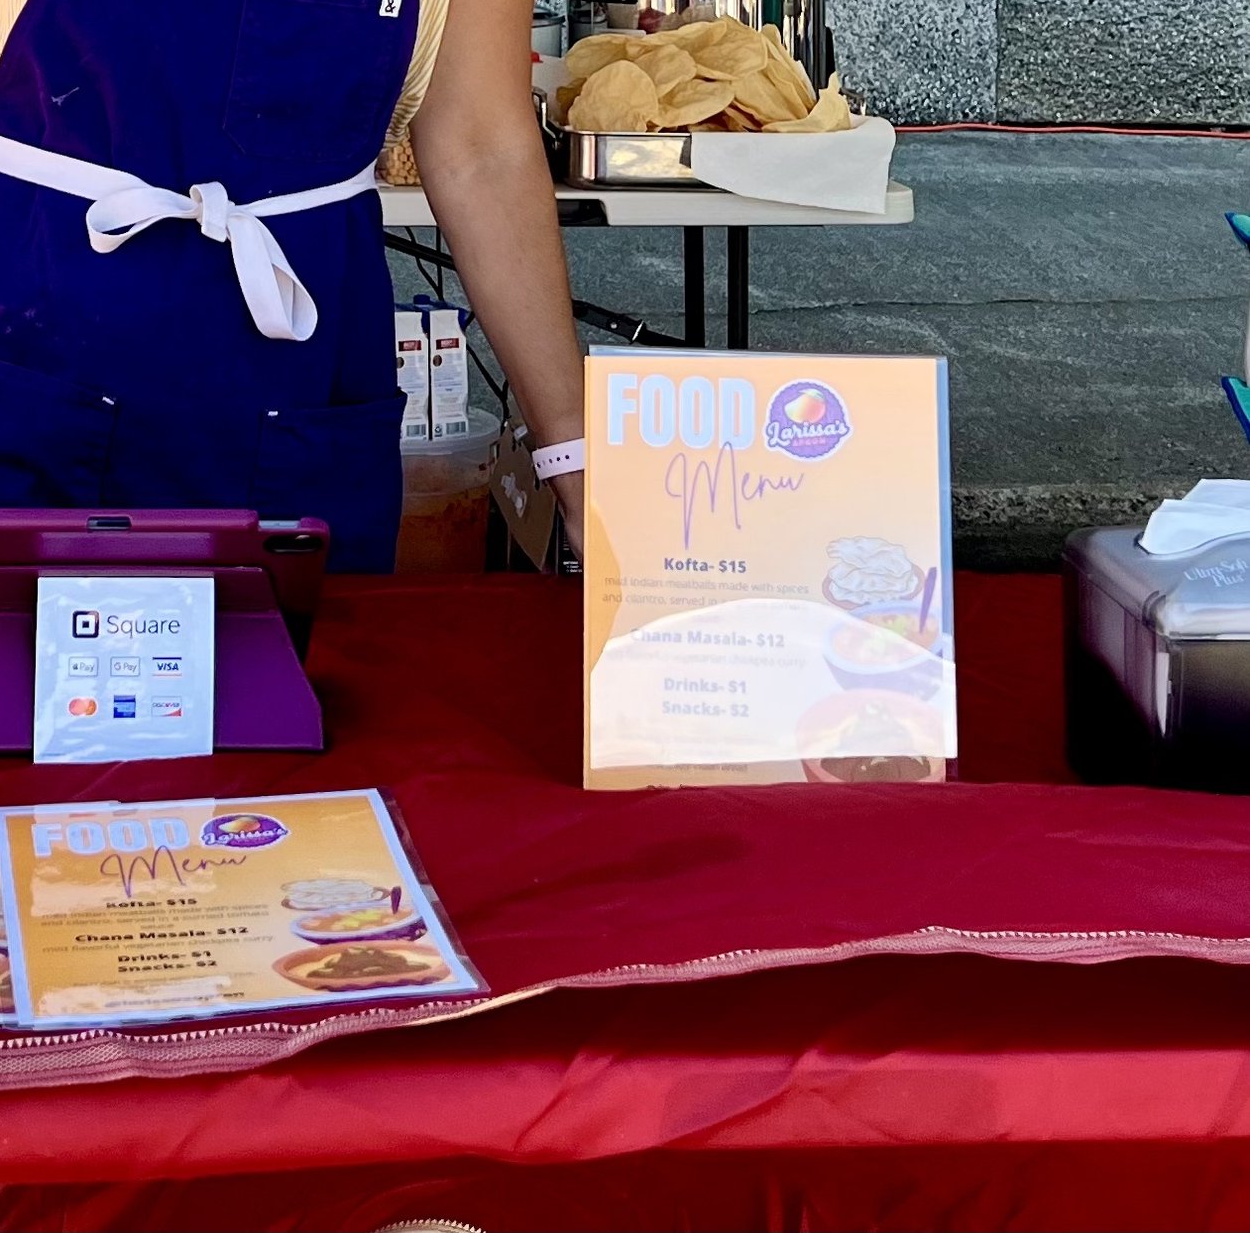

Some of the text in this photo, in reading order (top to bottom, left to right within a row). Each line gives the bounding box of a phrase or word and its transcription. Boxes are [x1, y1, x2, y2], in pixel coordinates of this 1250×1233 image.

[607, 373, 756, 450] FOOD
[766, 420, 849, 447] Larissa's
[665, 441, 804, 550] Menu
[664, 557, 747, 573] Kofta- $15
[719, 581, 749, 591] made
[751, 582, 775, 593] with
[776, 583, 809, 595] spices
[602, 592, 622, 603] and
[670, 595, 705, 606] served
[107, 615, 181, 639] Square
[687, 630, 752, 646] Masala-
[756, 633, 785, 647] $12
[124, 662, 137, 672] Pay
[157, 662, 179, 671] VISA
[663, 677, 724, 693] Drinks-
[662, 701, 726, 716] Snacks-
[32, 817, 190, 857] FOOD
[100, 845, 247, 898] Menu
[75, 933, 133, 942] Chana
[139, 929, 211, 940] Masala-
[117, 952, 187, 963] Drinks-
[117, 962, 192, 973] Snacks-
